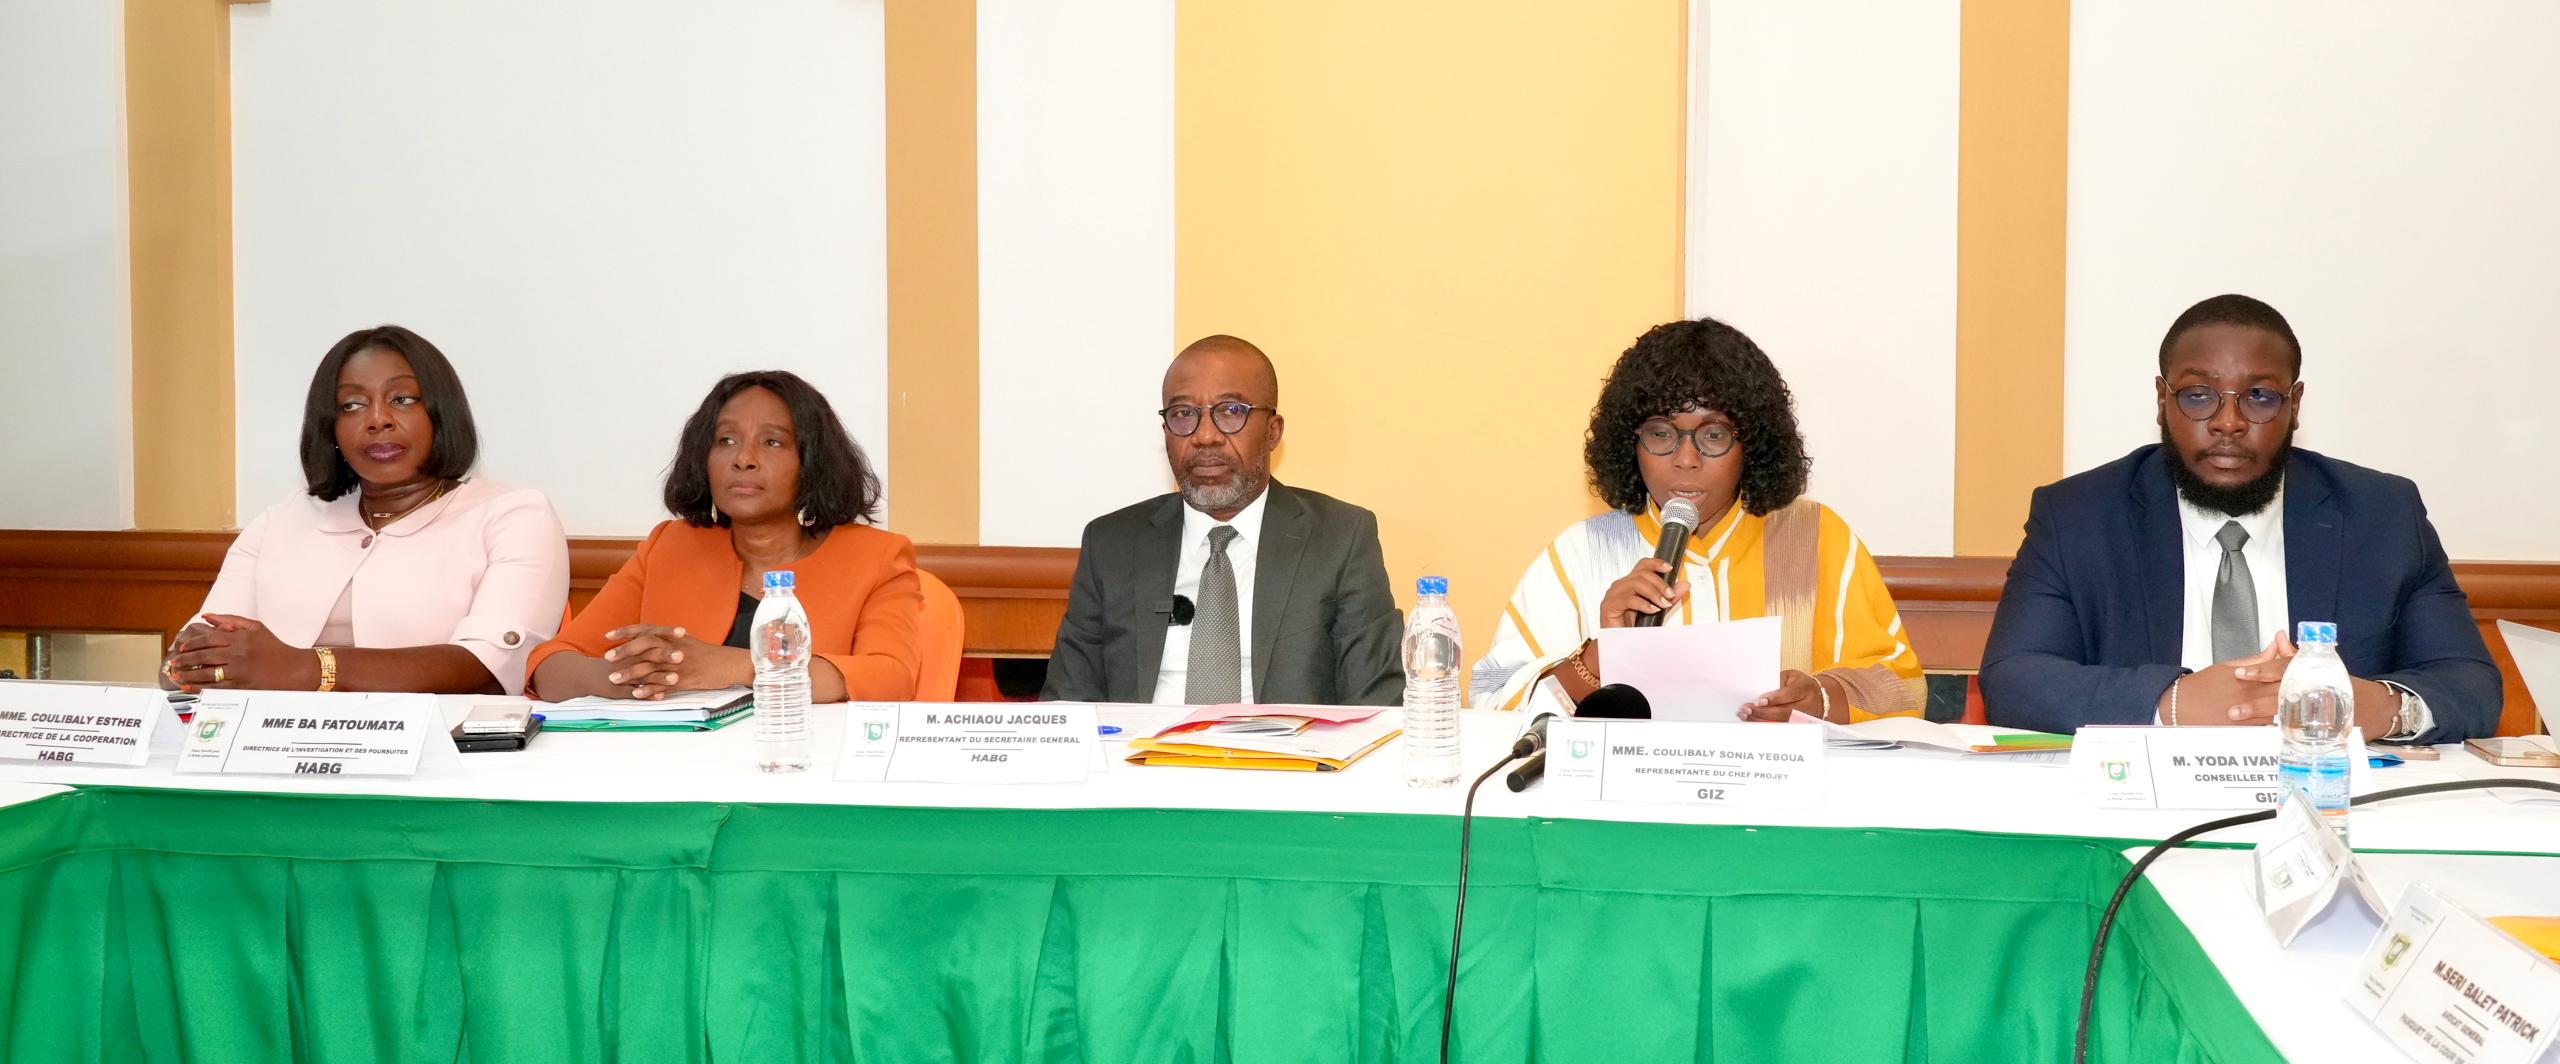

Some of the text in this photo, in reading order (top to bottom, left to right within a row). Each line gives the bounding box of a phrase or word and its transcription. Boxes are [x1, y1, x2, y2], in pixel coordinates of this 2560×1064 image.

[0, 711, 142, 728] MME. COULIBALY ESTHER
[262, 718, 405, 731] MME BA FATOUMATA
[926, 714, 1067, 725] M. ACHIAOU JACQUES
[46, 732, 57, 740] DE
[59, 733, 71, 741] LA
[73, 734, 137, 746] COOPERATION
[984, 736, 1037, 744] SECRETAIRE
[38, 750, 74, 761] HABG
[970, 754, 1008, 763] HABG
[1612, 745, 1805, 762] MME. COULIBALY SONIA YEBOUA
[2173, 755, 2190, 766] M.
[2195, 755, 2238, 767] YODA
[294, 762, 342, 774] HABG
[1635, 767, 1710, 776] REPRESENTANTE
[1754, 772, 1789, 780] PROJET
[2194, 774, 2265, 782] CONSEILLER
[1697, 788, 1725, 800] GIZ
[2432, 960, 2540, 1043] M.SERI BALET PATRICK
[2399, 1013, 2426, 1037] PARQUET
[2423, 1032, 2435, 1044] DE
[2430, 1038, 2441, 1049] LA
[2441, 1010, 2486, 1047] AVOCAT GENERAL
